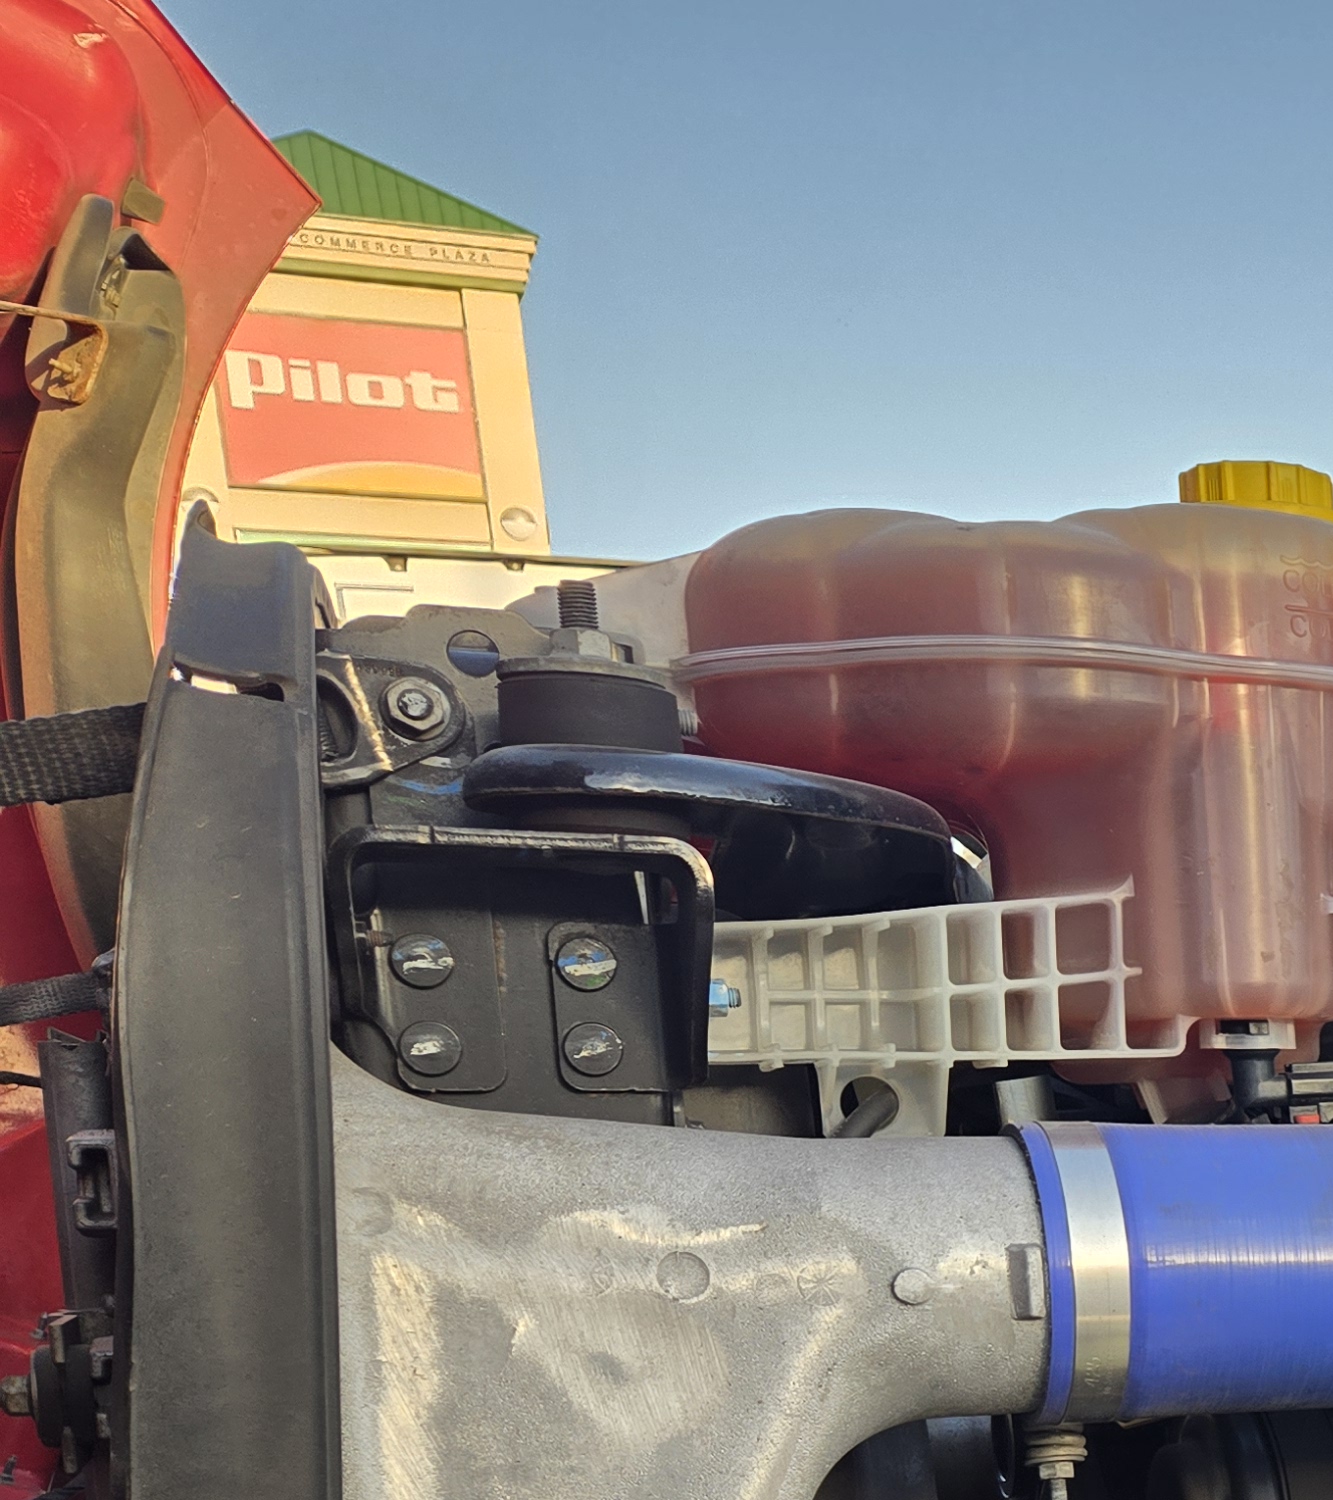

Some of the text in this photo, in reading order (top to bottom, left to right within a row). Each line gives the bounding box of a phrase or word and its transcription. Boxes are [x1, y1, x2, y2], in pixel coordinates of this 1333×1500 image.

[299, 233, 490, 263] COMMERCE PLAZA
[225, 349, 459, 414] Pilot
